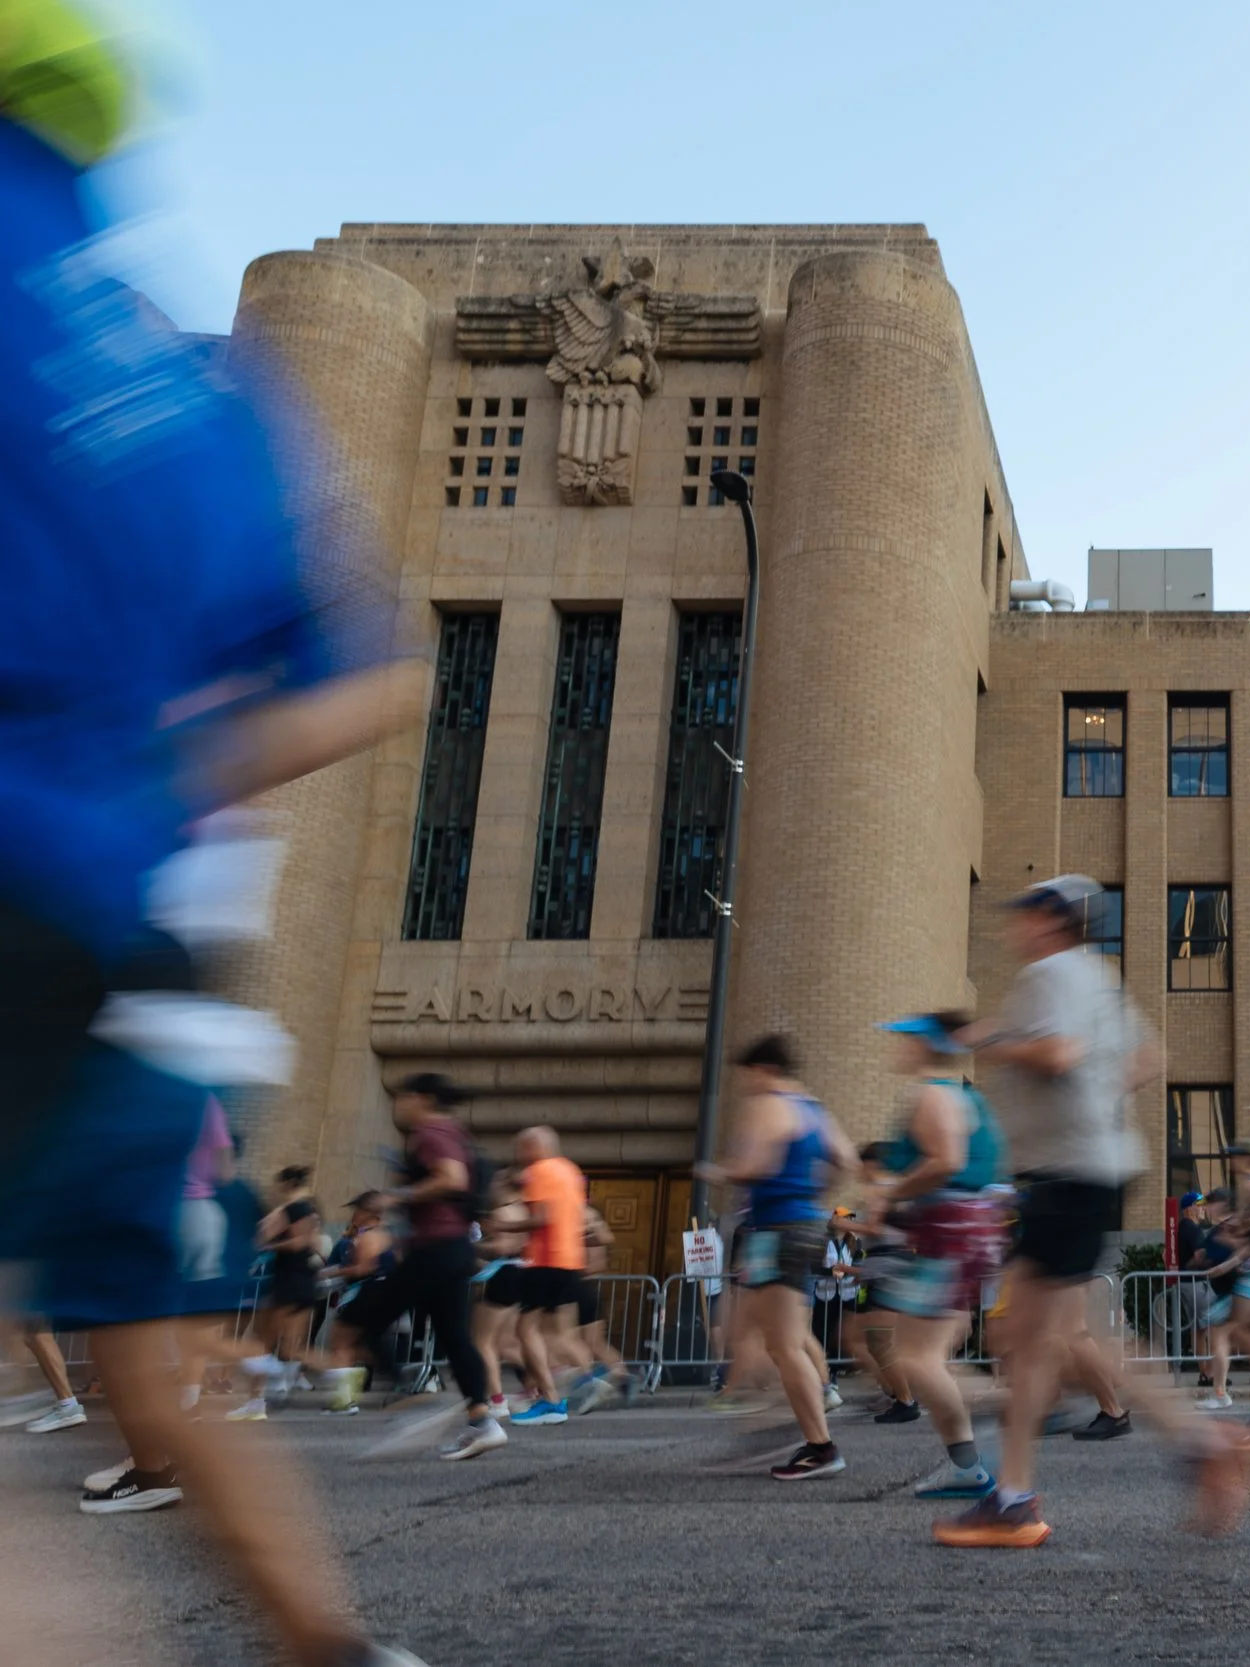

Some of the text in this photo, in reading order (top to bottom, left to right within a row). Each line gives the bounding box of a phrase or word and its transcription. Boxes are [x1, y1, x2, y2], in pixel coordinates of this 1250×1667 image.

[413, 985, 672, 1023] ARMORY
[694, 1236, 705, 1245] NO
[688, 1246, 713, 1255] PARKING
[112, 1484, 138, 1499] HOKA
